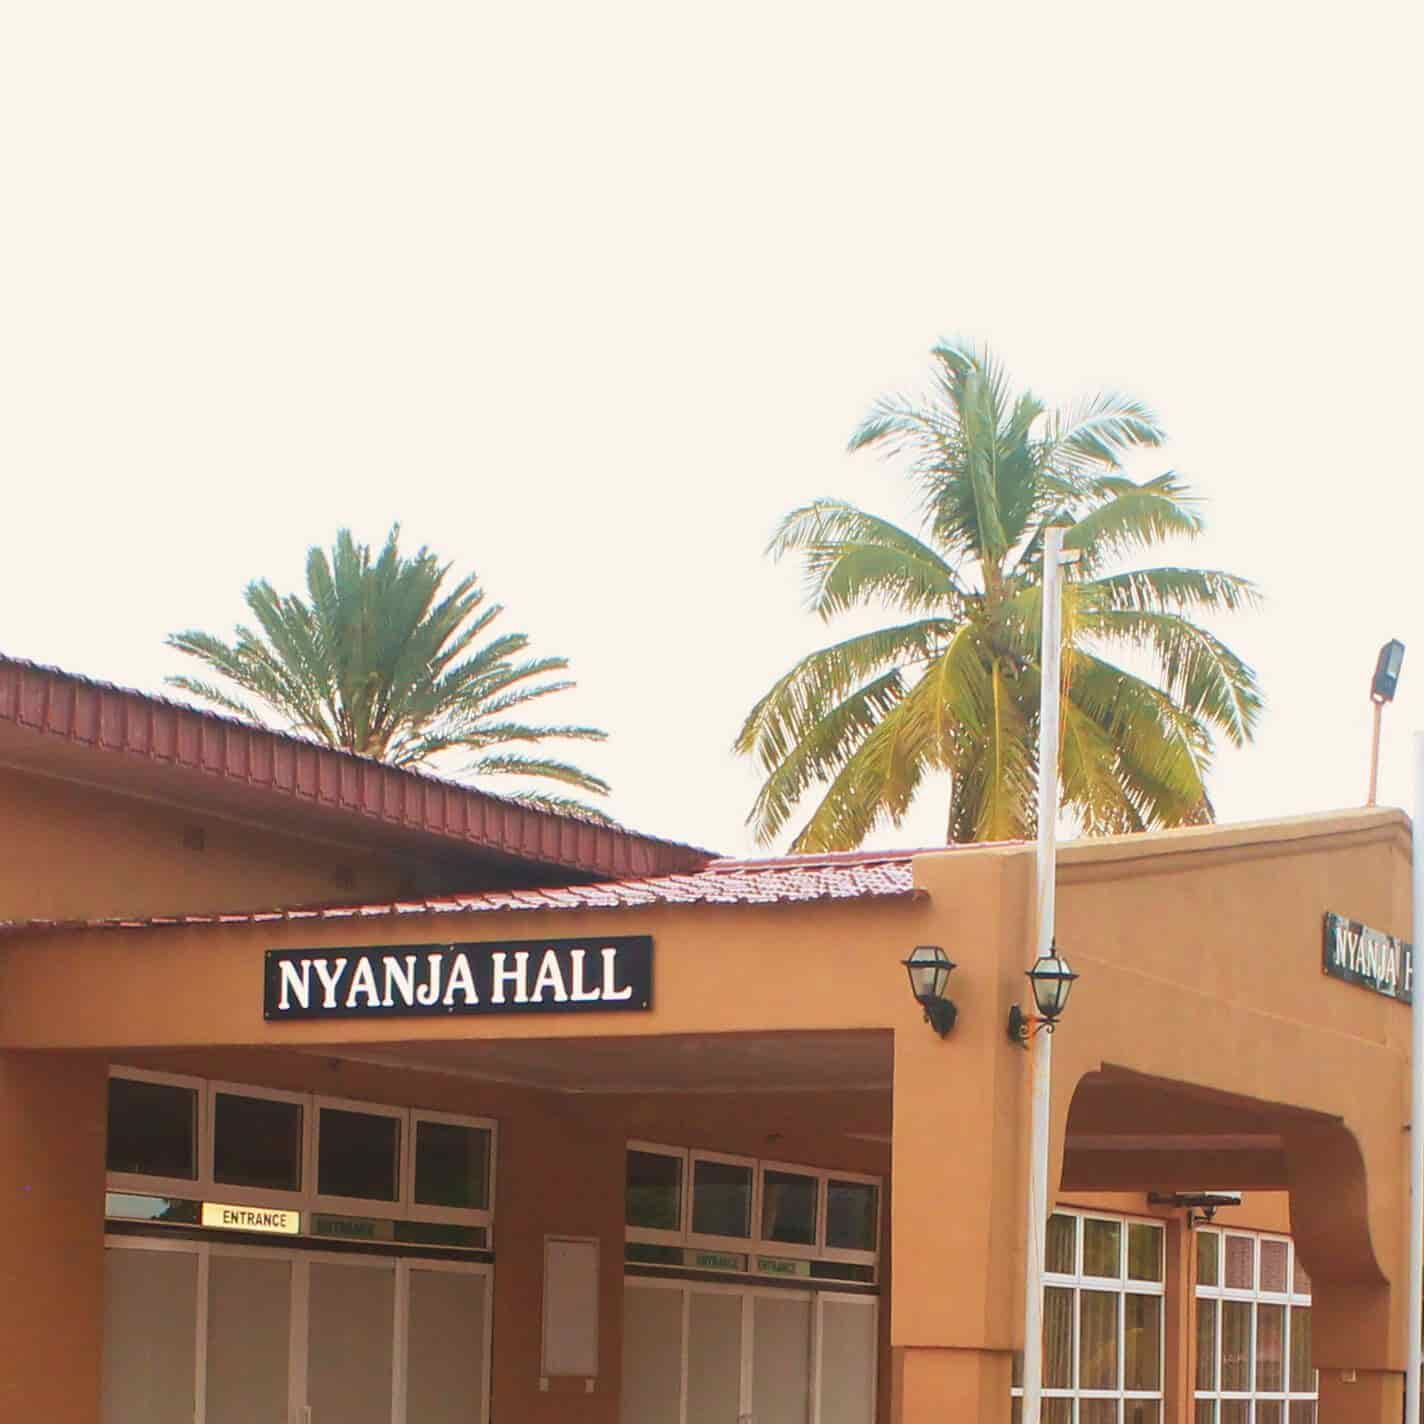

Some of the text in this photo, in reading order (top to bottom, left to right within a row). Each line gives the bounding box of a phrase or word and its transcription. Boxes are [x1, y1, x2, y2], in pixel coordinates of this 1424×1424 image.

[278, 948, 632, 1010] NYANJA HALL
[1335, 926, 1398, 985] NYANJA
[223, 1210, 287, 1227] ENTRANCE
